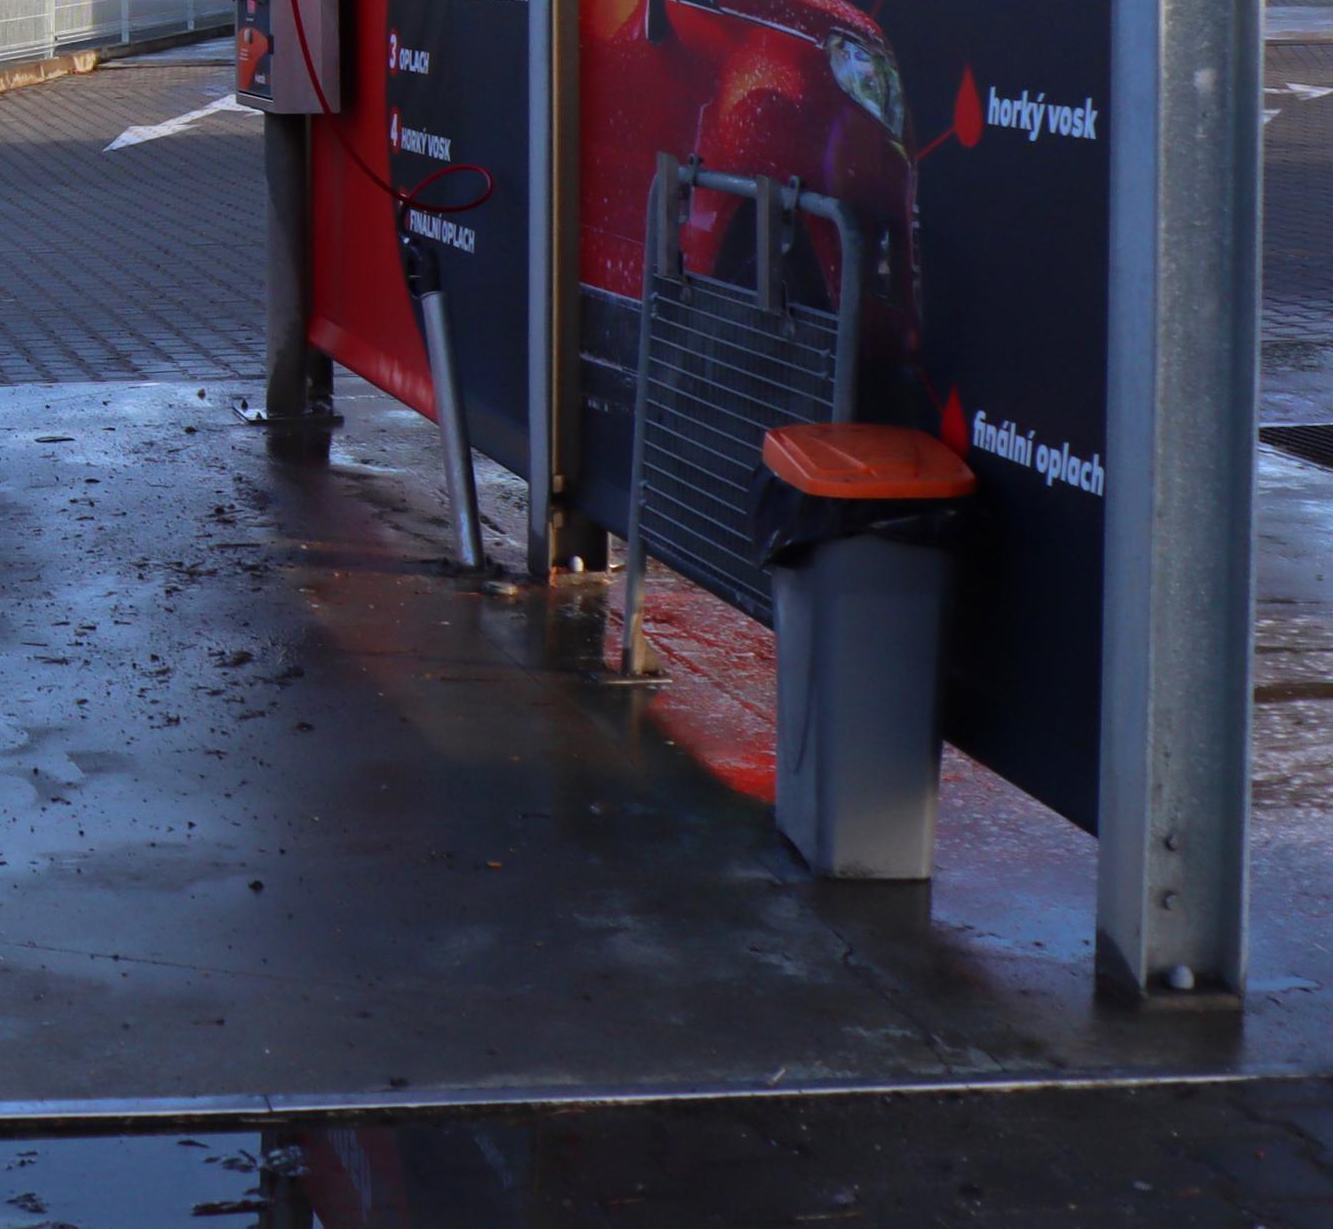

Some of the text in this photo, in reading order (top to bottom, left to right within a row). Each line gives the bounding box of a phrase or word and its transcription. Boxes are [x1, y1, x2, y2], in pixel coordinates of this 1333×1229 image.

[389, 33, 430, 75] 3 OPLACH
[390, 113, 452, 163] 4 HORKÝ VOSK
[987, 86, 1099, 142] horký vosk
[442, 219, 475, 254] OPLACH
[973, 410, 1105, 497] finální oplach
